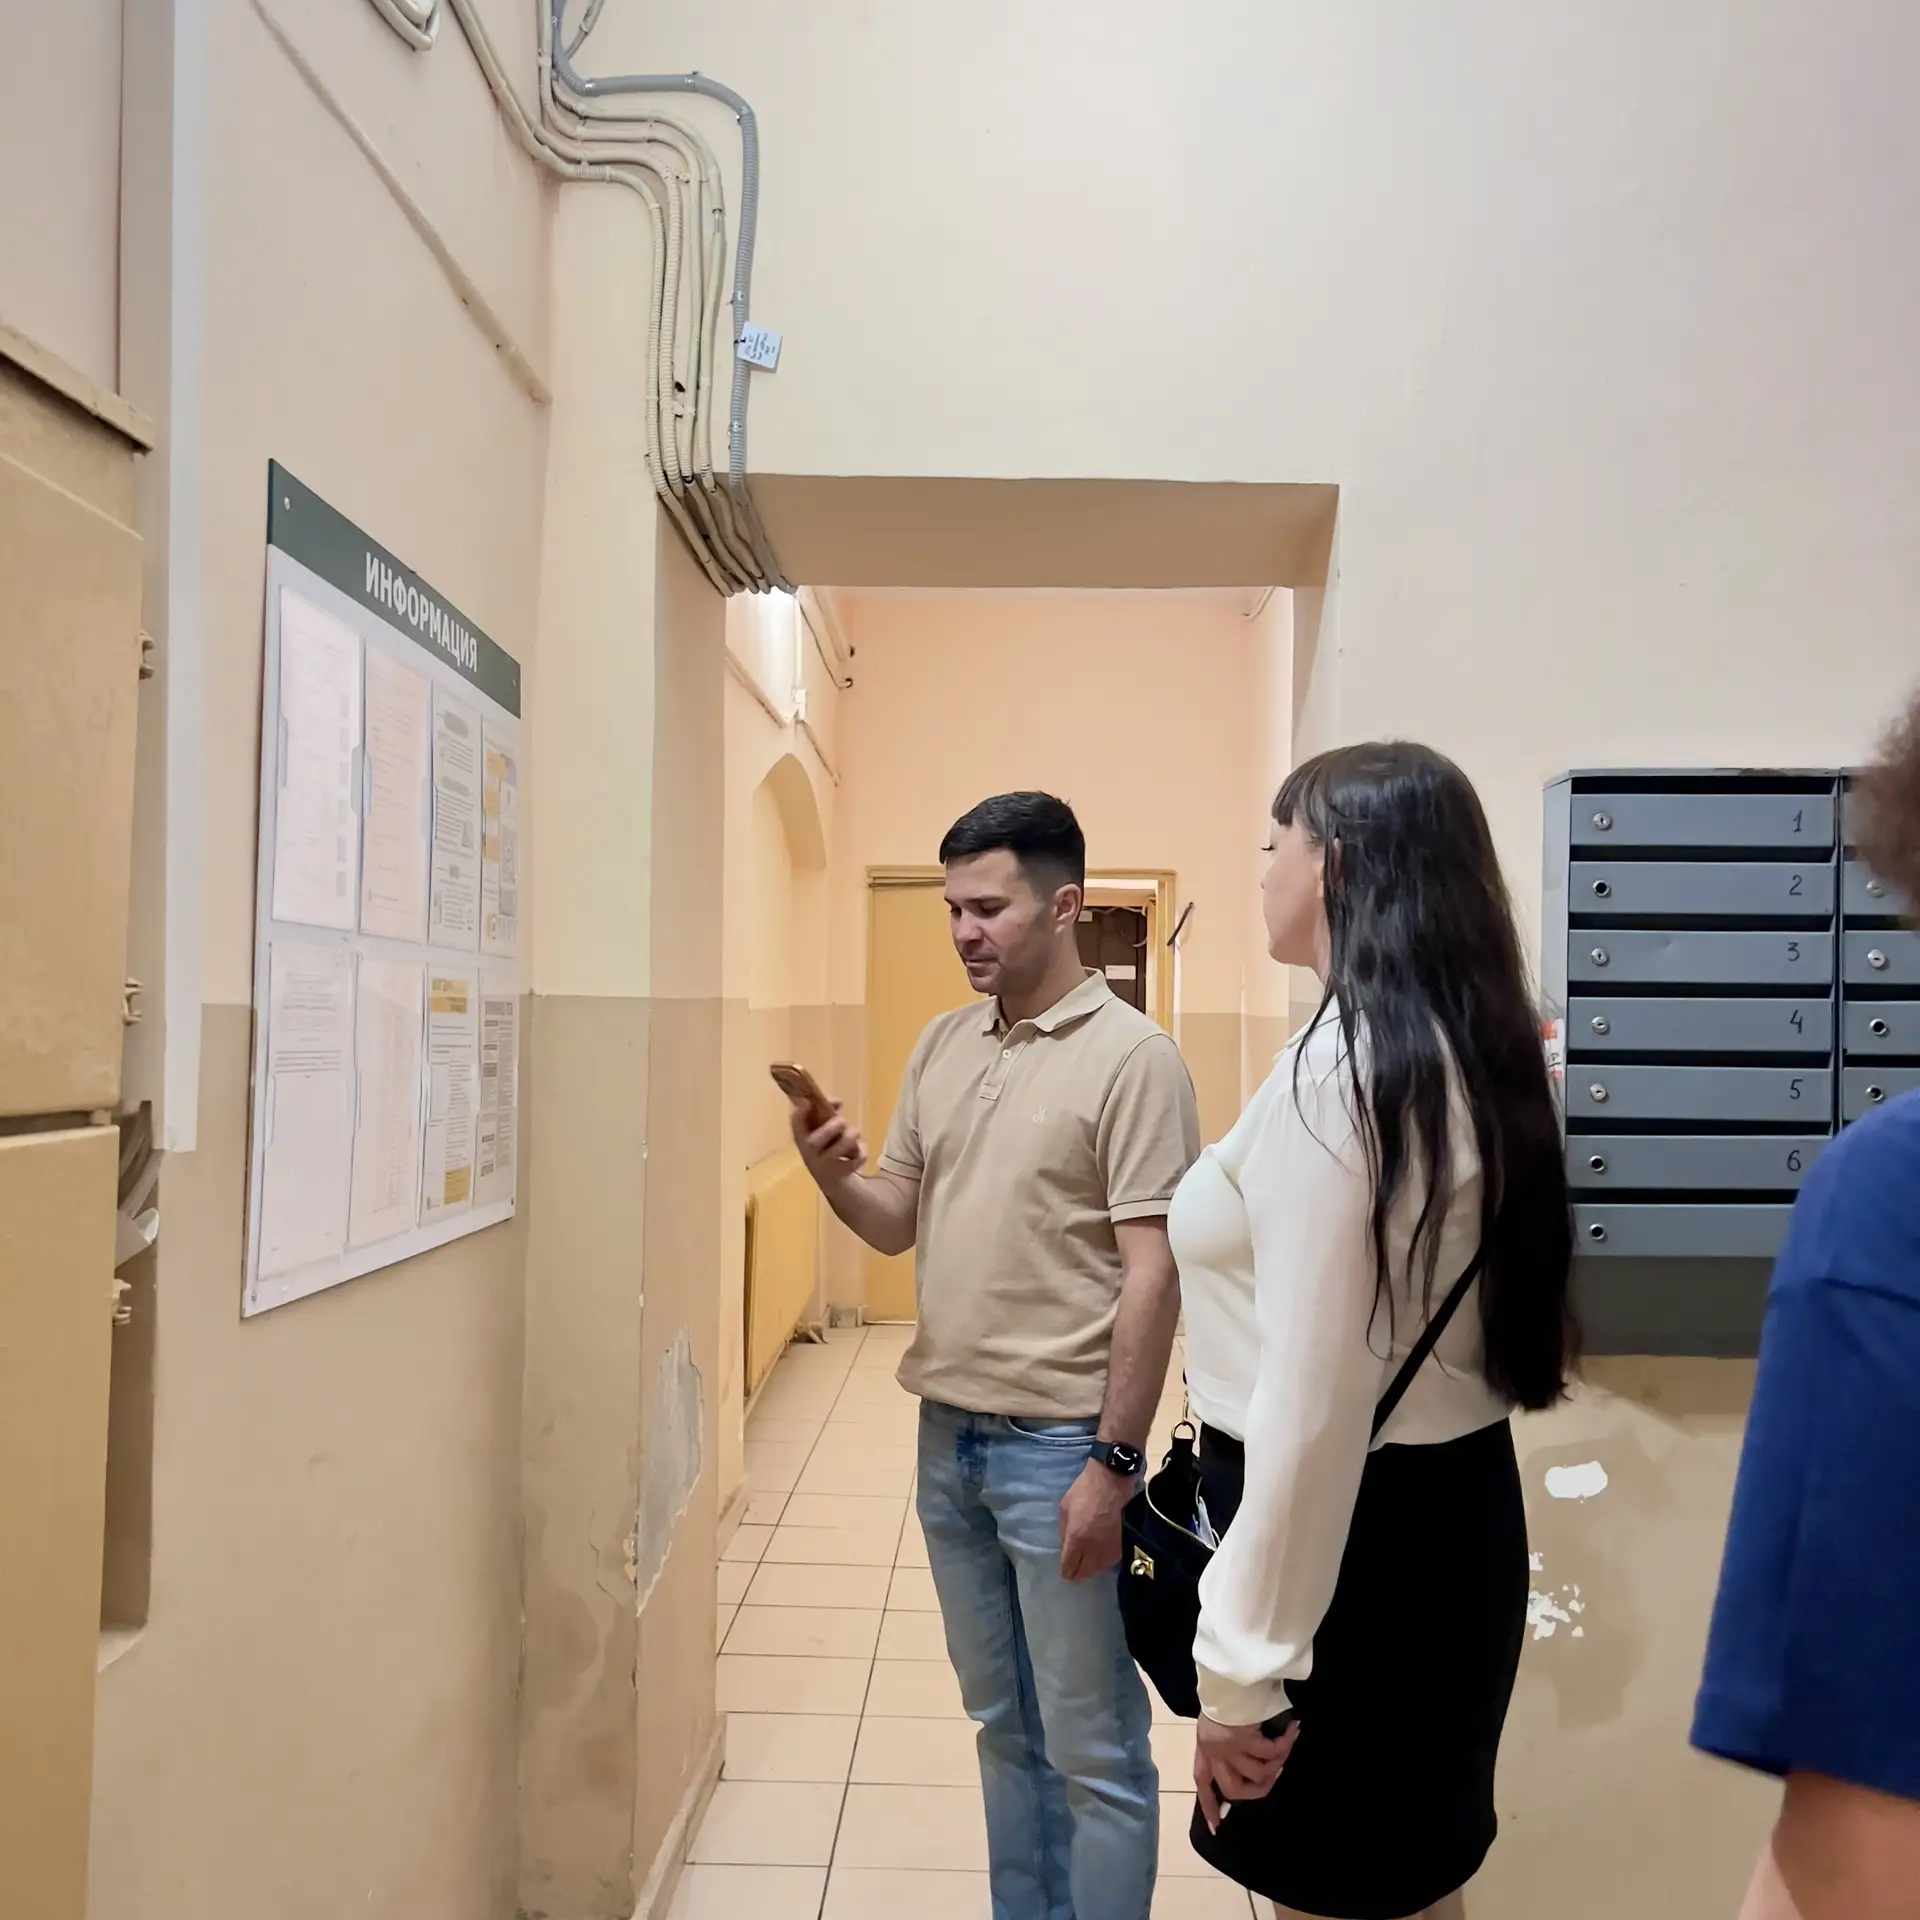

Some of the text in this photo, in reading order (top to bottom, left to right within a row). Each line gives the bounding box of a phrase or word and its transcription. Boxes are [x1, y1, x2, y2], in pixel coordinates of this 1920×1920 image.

[365, 551, 478, 672] ИНФОРМАЦИЯ
[1792, 809, 1803, 833] 1
[1789, 874, 1803, 896] 2
[1787, 942, 1801, 962] 3
[1789, 1009, 1803, 1034] 4
[1789, 1079, 1804, 1100] 5
[1786, 1150, 1802, 1172] 6
